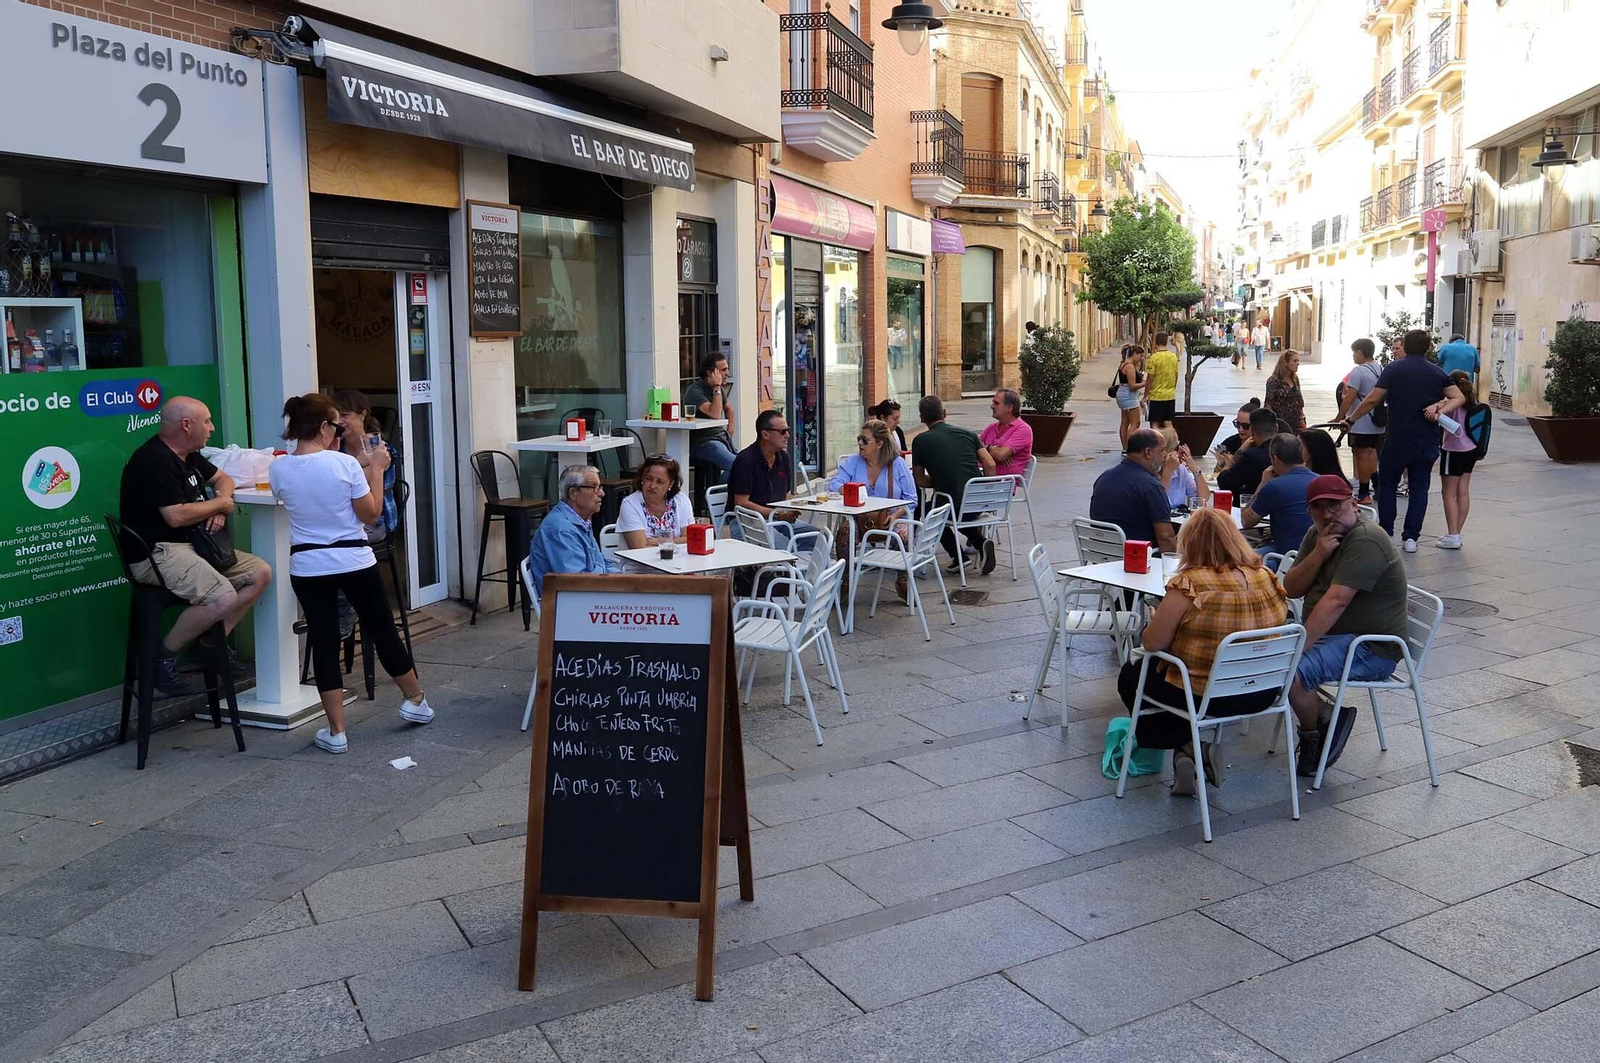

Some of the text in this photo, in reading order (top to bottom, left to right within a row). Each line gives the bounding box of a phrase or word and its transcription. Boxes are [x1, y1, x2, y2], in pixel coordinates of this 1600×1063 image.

[52, 22, 248, 87] Plaza del Punto
[341, 76, 449, 118] VICTORIA
[137, 82, 185, 163] 2
[380, 107, 421, 122] DESDE 1928
[570, 134, 690, 180] EL BAR DE DIEGO
[757, 178, 774, 402] BAZAR
[520, 336, 534, 352] EL
[417, 382, 431, 392] ESN
[45, 391, 71, 410] de
[86, 393, 99, 407] El
[103, 391, 134, 405] Club
[16, 526, 24, 534] Si
[25, 524, 42, 532] eres
[43, 520, 68, 529] mayor
[69, 517, 79, 525] de
[15, 534, 97, 557] ahórrate el IVA
[28, 534, 39, 542] de
[40, 532, 51, 540] 30
[29, 550, 68, 564] productos
[71, 556, 93, 566] importe
[32, 569, 64, 580] Descuento
[8, 597, 34, 609] hazte
[35, 591, 58, 603] socio
[60, 588, 71, 598] en
[72, 576, 129, 595] www.carrefo
[588, 612, 680, 626] VICTORIA
[624, 654, 702, 683] TRASMALLO
[617, 686, 651, 709] PUNTA
[595, 712, 641, 731] ENTERO
[619, 745, 637, 761] DE
[604, 778, 624, 795] DE
